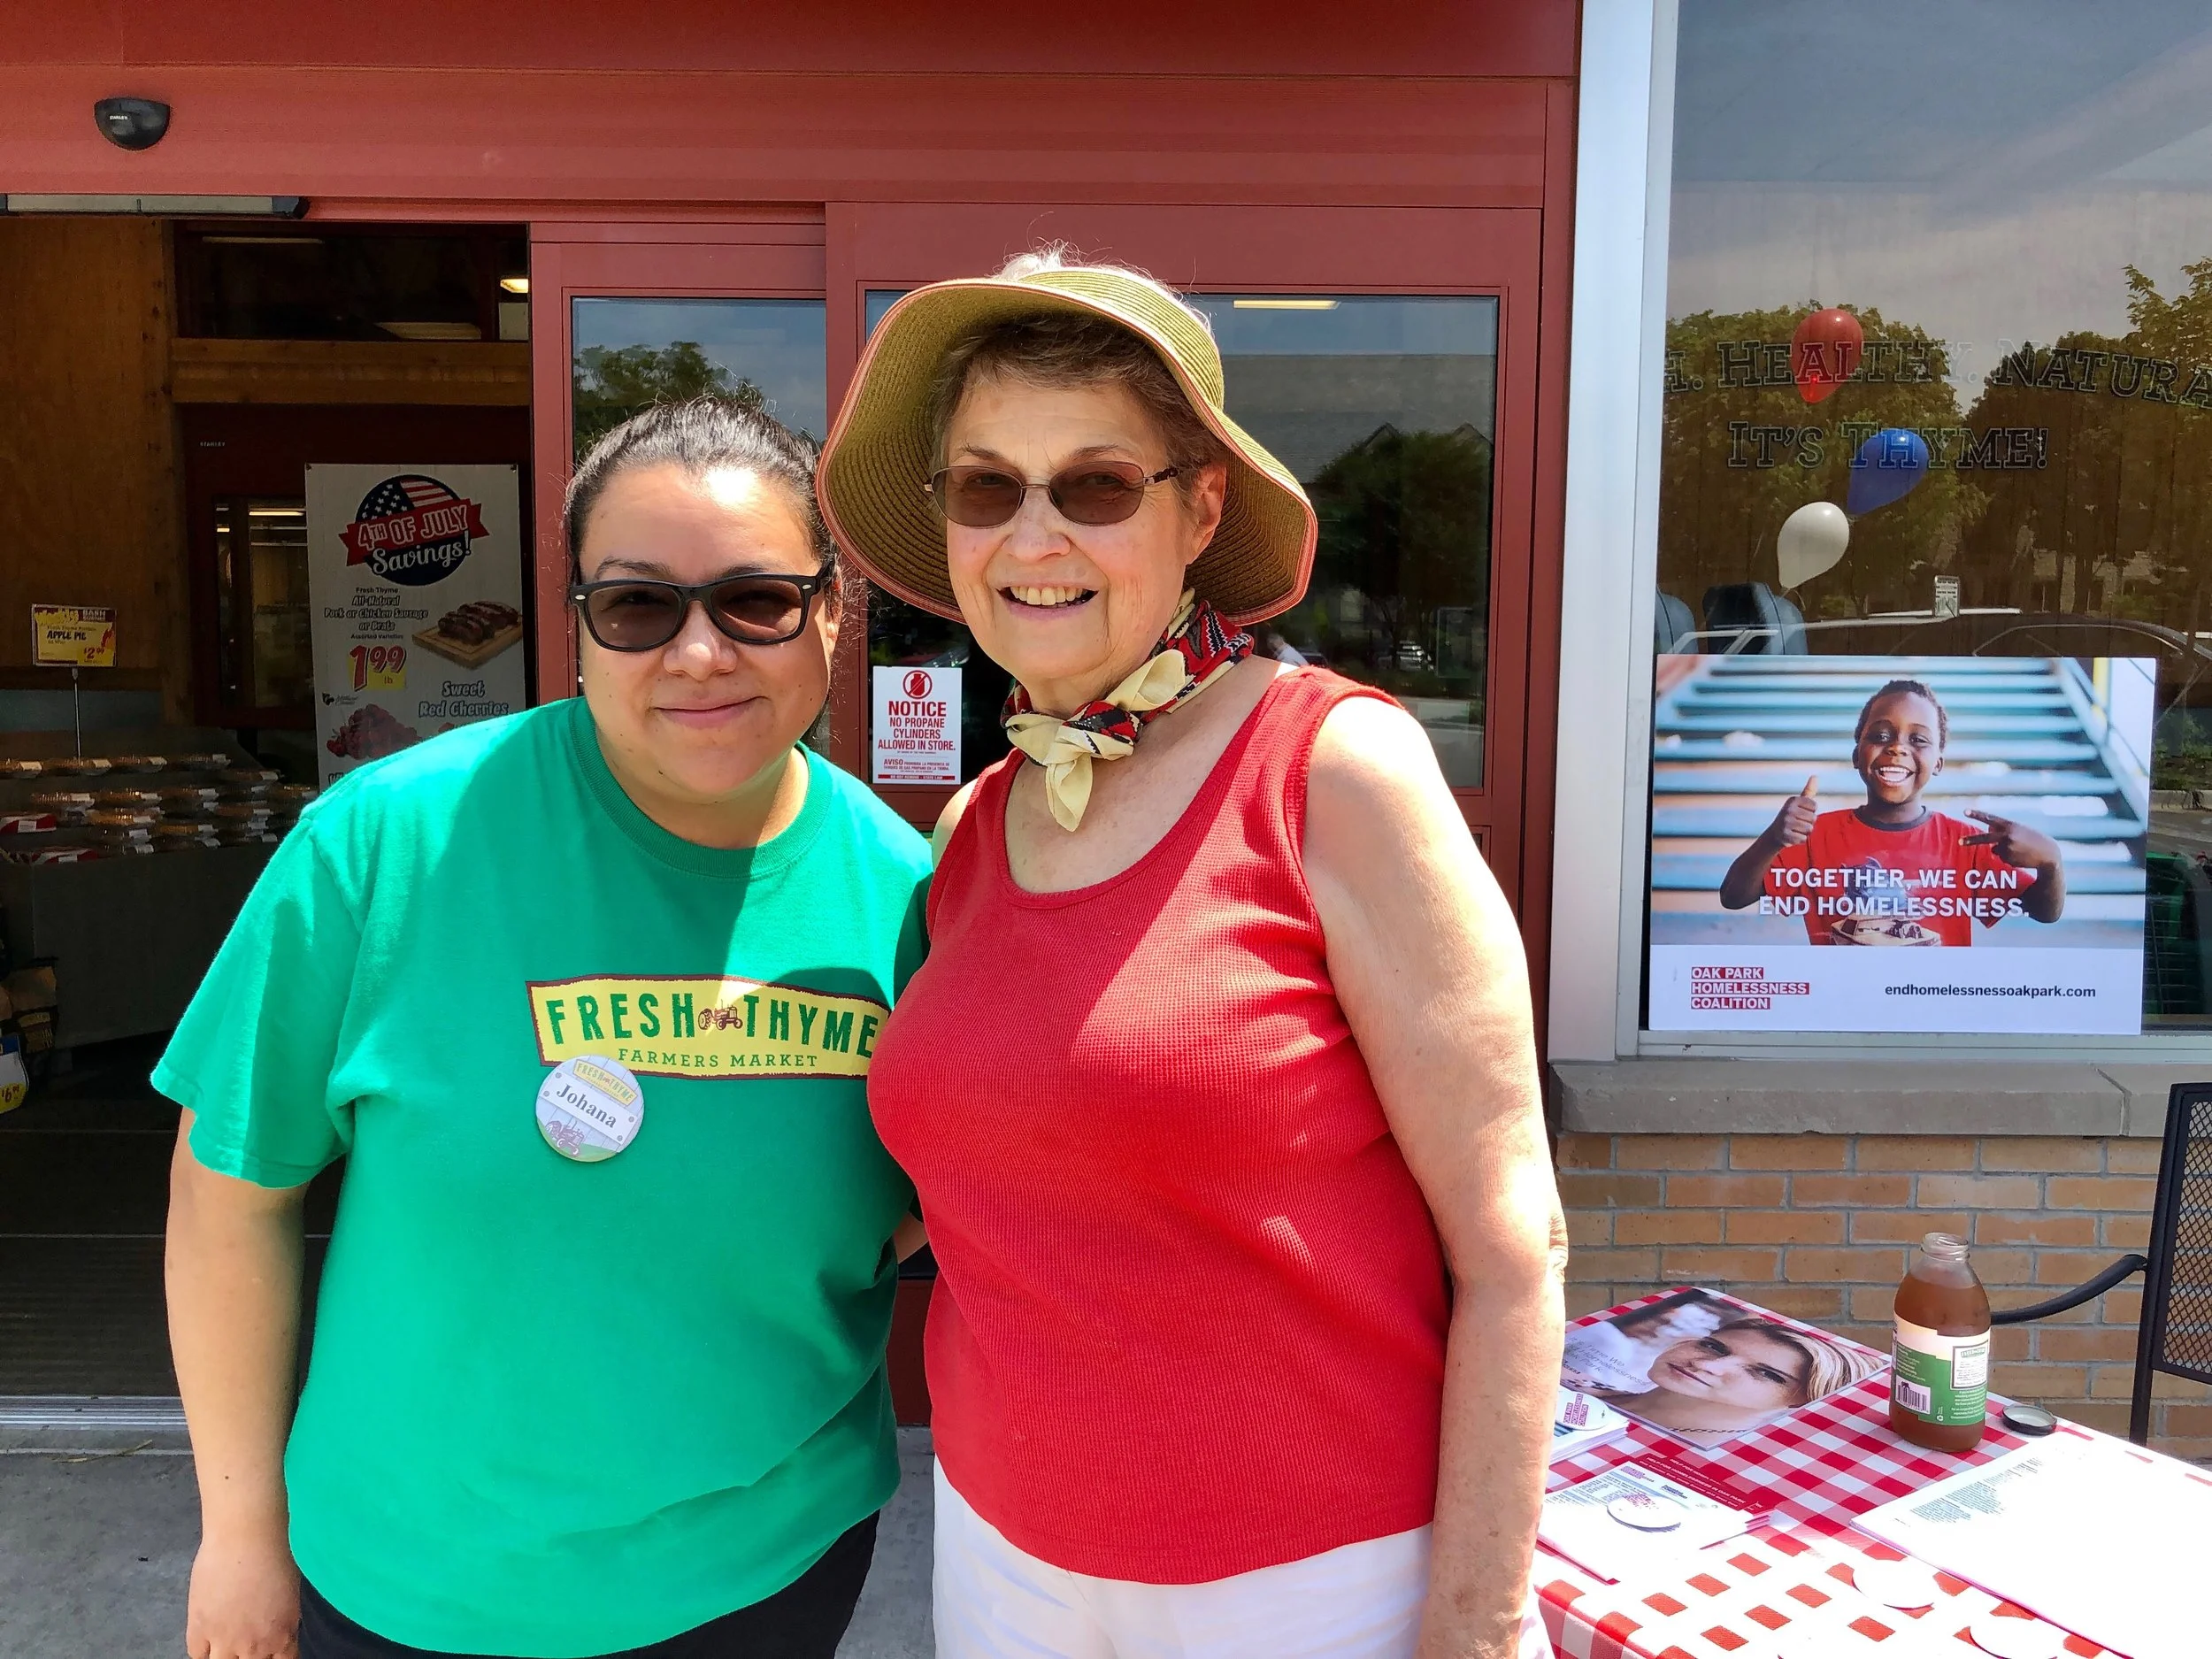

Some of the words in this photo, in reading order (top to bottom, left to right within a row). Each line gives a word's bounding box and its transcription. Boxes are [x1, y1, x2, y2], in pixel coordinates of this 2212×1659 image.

[1717, 340, 1979, 388] HEALTHY.
[1728, 420, 1824, 469] IT'S
[1840, 421, 2049, 469] THYME!
[357, 523, 388, 551] 4TH
[388, 516, 417, 545] OF
[420, 504, 469, 539] JULY
[373, 530, 472, 575] Savings!
[442, 680, 486, 697] Sweet
[419, 701, 447, 718] Red
[449, 701, 510, 717] Cherries
[887, 700, 947, 717] NOTICE
[889, 717, 902, 727] NO
[904, 718, 945, 728] PROPANE
[893, 728, 941, 740] CYLINDERS
[878, 739, 916, 750] ALLOWED
[918, 740, 926, 750] IN
[927, 740, 956, 751] STORE.
[1770, 867, 1912, 892] TOGETHER,
[1918, 869, 1956, 889] WE
[1964, 869, 2018, 890] CAN
[1758, 896, 1810, 916] END
[1817, 896, 2030, 918] HOMELESSNESS.
[1692, 967, 1721, 979] OAK
[1724, 967, 1763, 979] PARK
[1692, 983, 1807, 995] HOMELESSNESS
[1885, 984, 2097, 1000] endhomelessnessoakpark.com
[1691, 997, 1769, 1010] COALITION
[545, 992, 695, 1046] FRESH
[743, 995, 879, 1059] THYME
[618, 1048, 719, 1068] FARMERS
[730, 1054, 818, 1068] MARKET
[576, 1063, 605, 1081] FRESH
[608, 1078, 634, 1102] THYME
[556, 1082, 618, 1128] Johana
